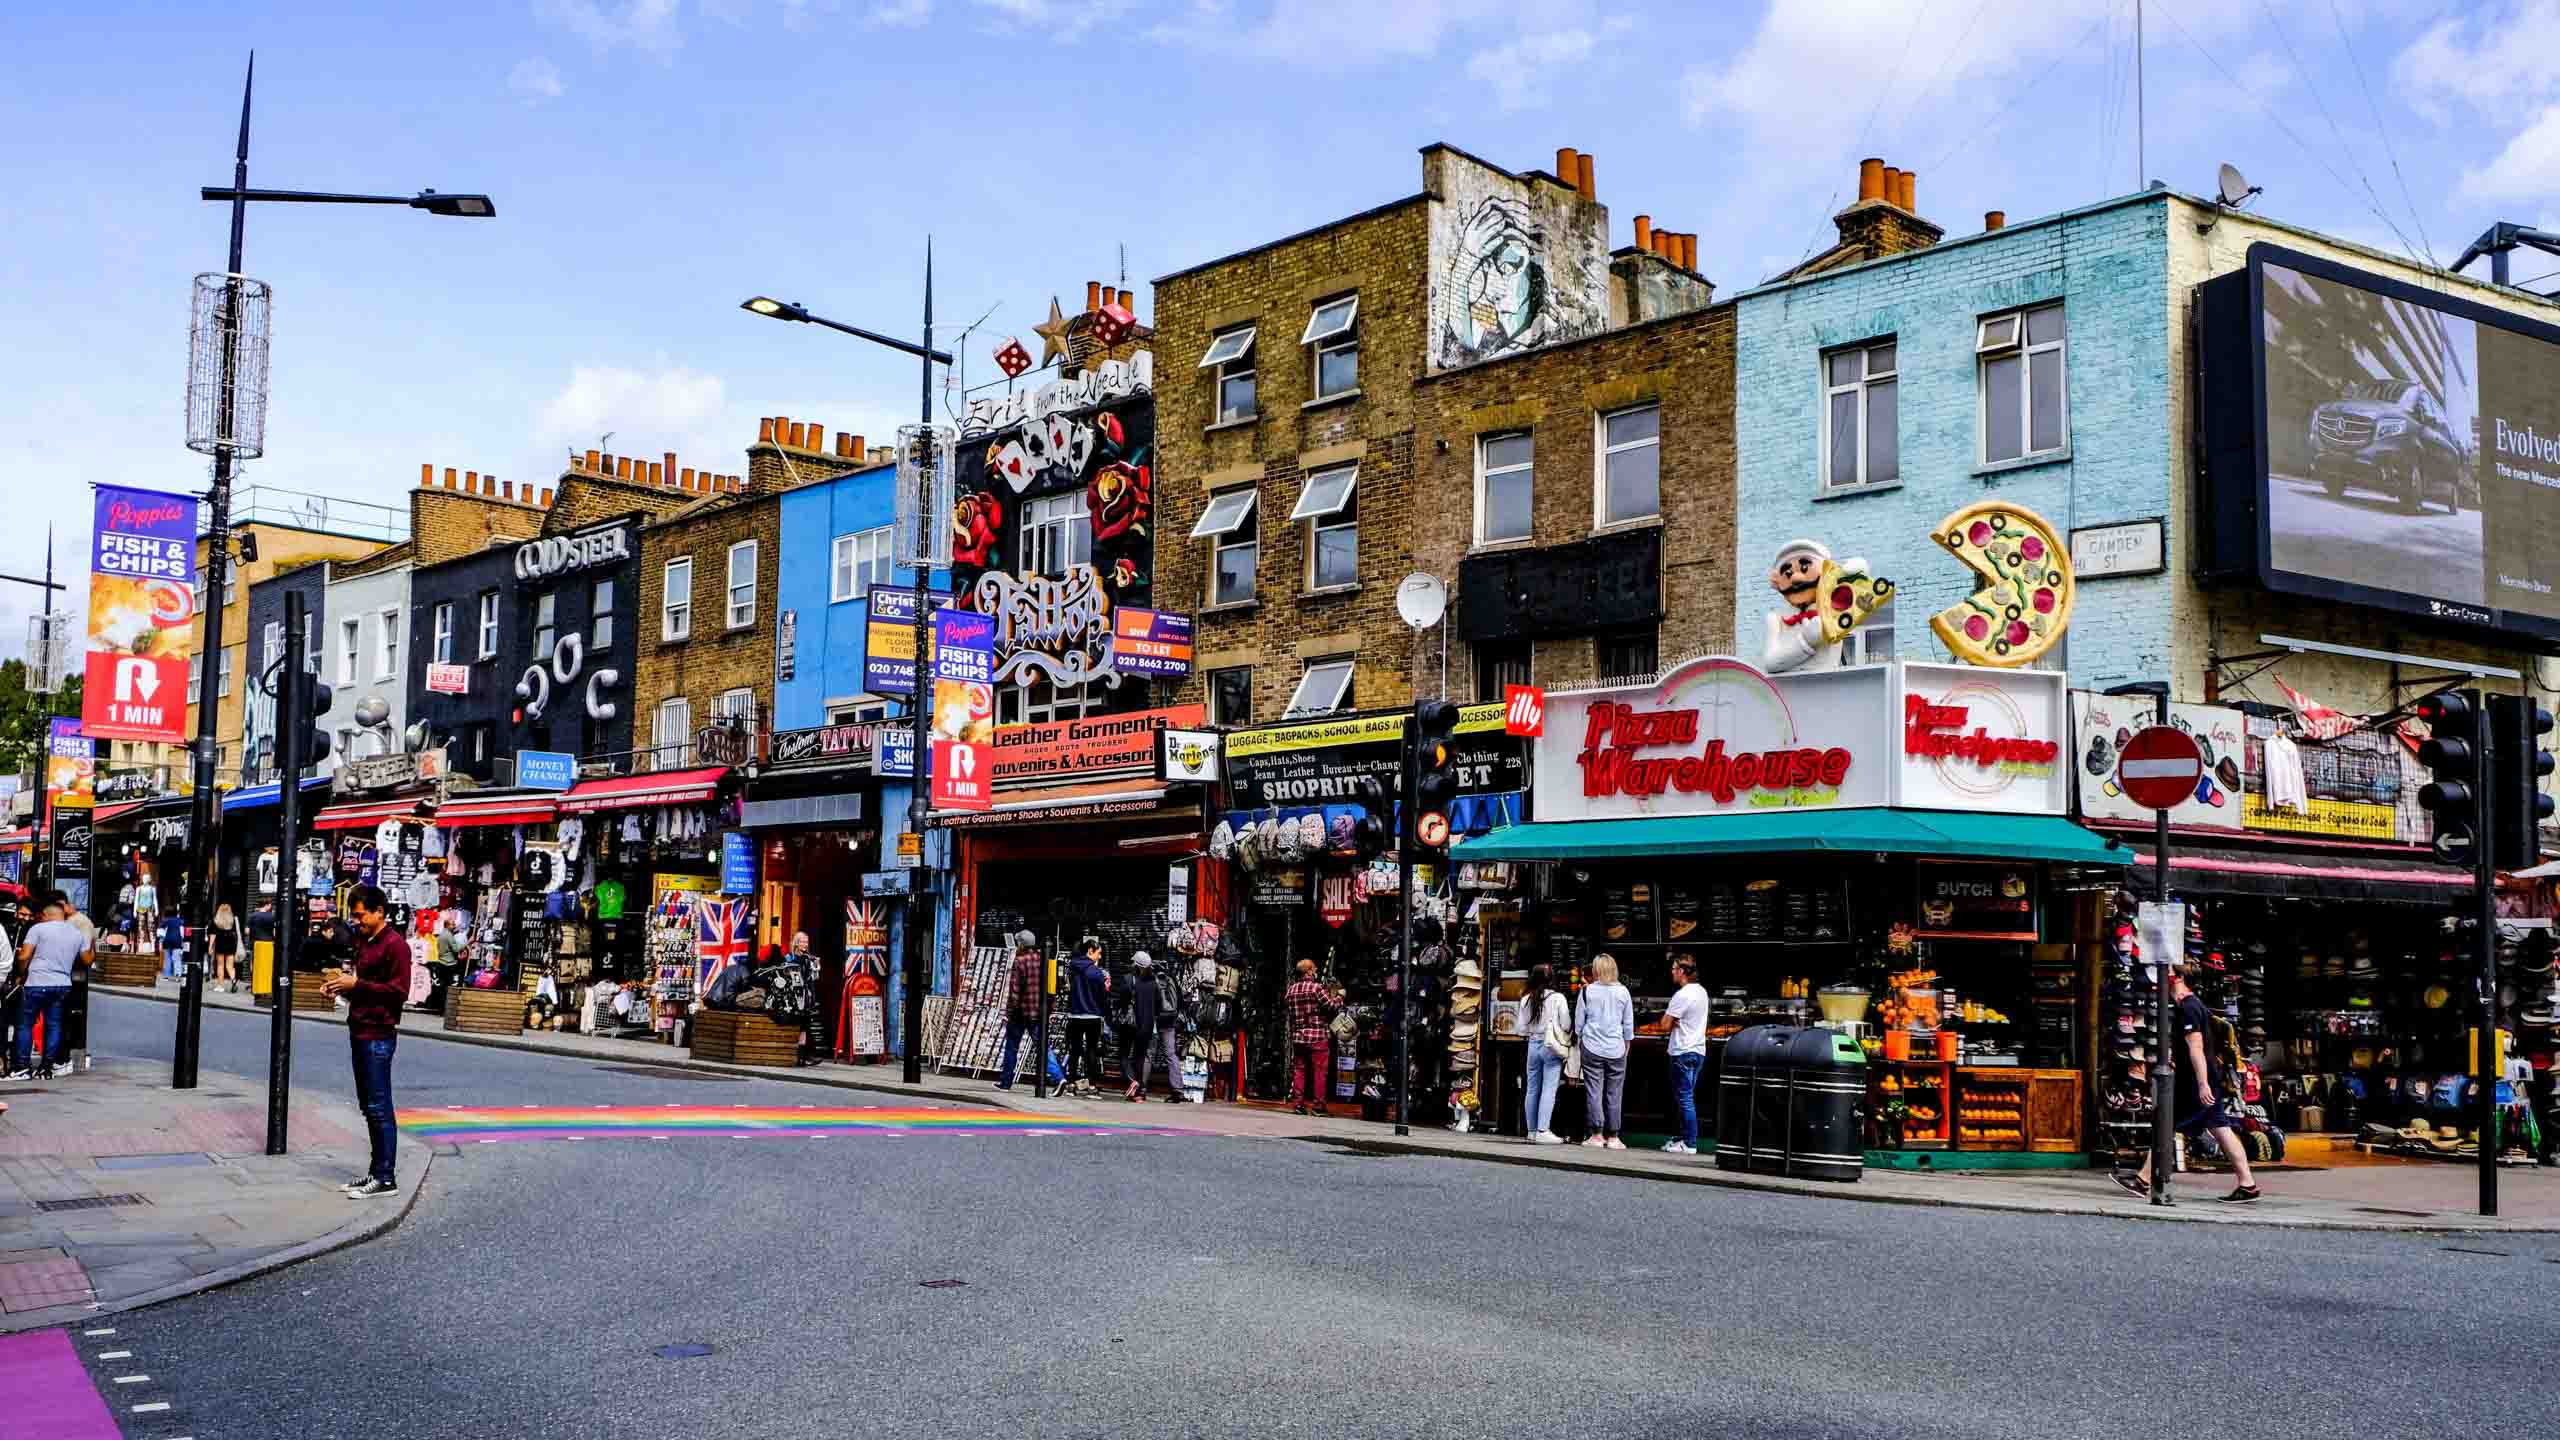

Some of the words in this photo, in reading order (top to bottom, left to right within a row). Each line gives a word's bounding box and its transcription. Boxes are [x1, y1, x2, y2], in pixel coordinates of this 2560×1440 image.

[108, 501, 184, 529] Poppies
[100, 534, 160, 557] FISH
[166, 543, 187, 561] &
[2089, 535, 2143, 554] CAMDEN
[100, 552, 187, 577] CHIPS
[2104, 554, 2119, 569] ST
[876, 593, 916, 607] Christ
[939, 648, 974, 665] FISH
[976, 653, 988, 667] &
[1136, 643, 1152, 654] TO
[1153, 644, 1169, 657] LET
[869, 663, 890, 674] 020
[893, 664, 915, 676] 748
[939, 661, 988, 680] CHIPS
[1118, 656, 1136, 666] 020
[1139, 658, 1162, 669] 8662
[1164, 661, 1186, 671] 2700
[432, 674, 444, 682] TO
[108, 704, 117, 721] 1
[123, 705, 163, 725] MIN
[1508, 692, 1542, 732] illy
[992, 727, 1062, 749] Leather
[1068, 715, 1168, 741] Garments
[1228, 733, 1268, 748] LUGGAGE
[1274, 727, 1322, 743] BAGPACKS,
[1324, 723, 1361, 737] SCHOOL
[1365, 721, 1390, 733] BAGS
[1584, 700, 1699, 750] Pizza
[526, 759, 566, 771] MONEY
[993, 757, 1057, 776] ouvenirs
[1060, 754, 1072, 769] &
[1075, 746, 1155, 769] Accessori
[1505, 757, 1522, 769] 228
[522, 769, 569, 783] CHANGE
[1254, 770, 1276, 781] Jeans
[1283, 767, 1315, 779] Leather
[1577, 739, 1851, 803] Warehouse
[946, 781, 952, 795] 1
[955, 782, 978, 797] MIN
[1233, 779, 1248, 791] 228
[940, 815, 970, 826] Leather
[972, 811, 1013, 824] Garments
[1018, 809, 1044, 820] Shoes
[1049, 806, 1092, 817] Souvenirs
[1093, 804, 1100, 813] &
[1102, 799, 1157, 813] Accessories
[1322, 877, 1352, 910] SALE
[1936, 881, 1993, 896] DUTCH
[848, 927, 888, 945] LONDON
